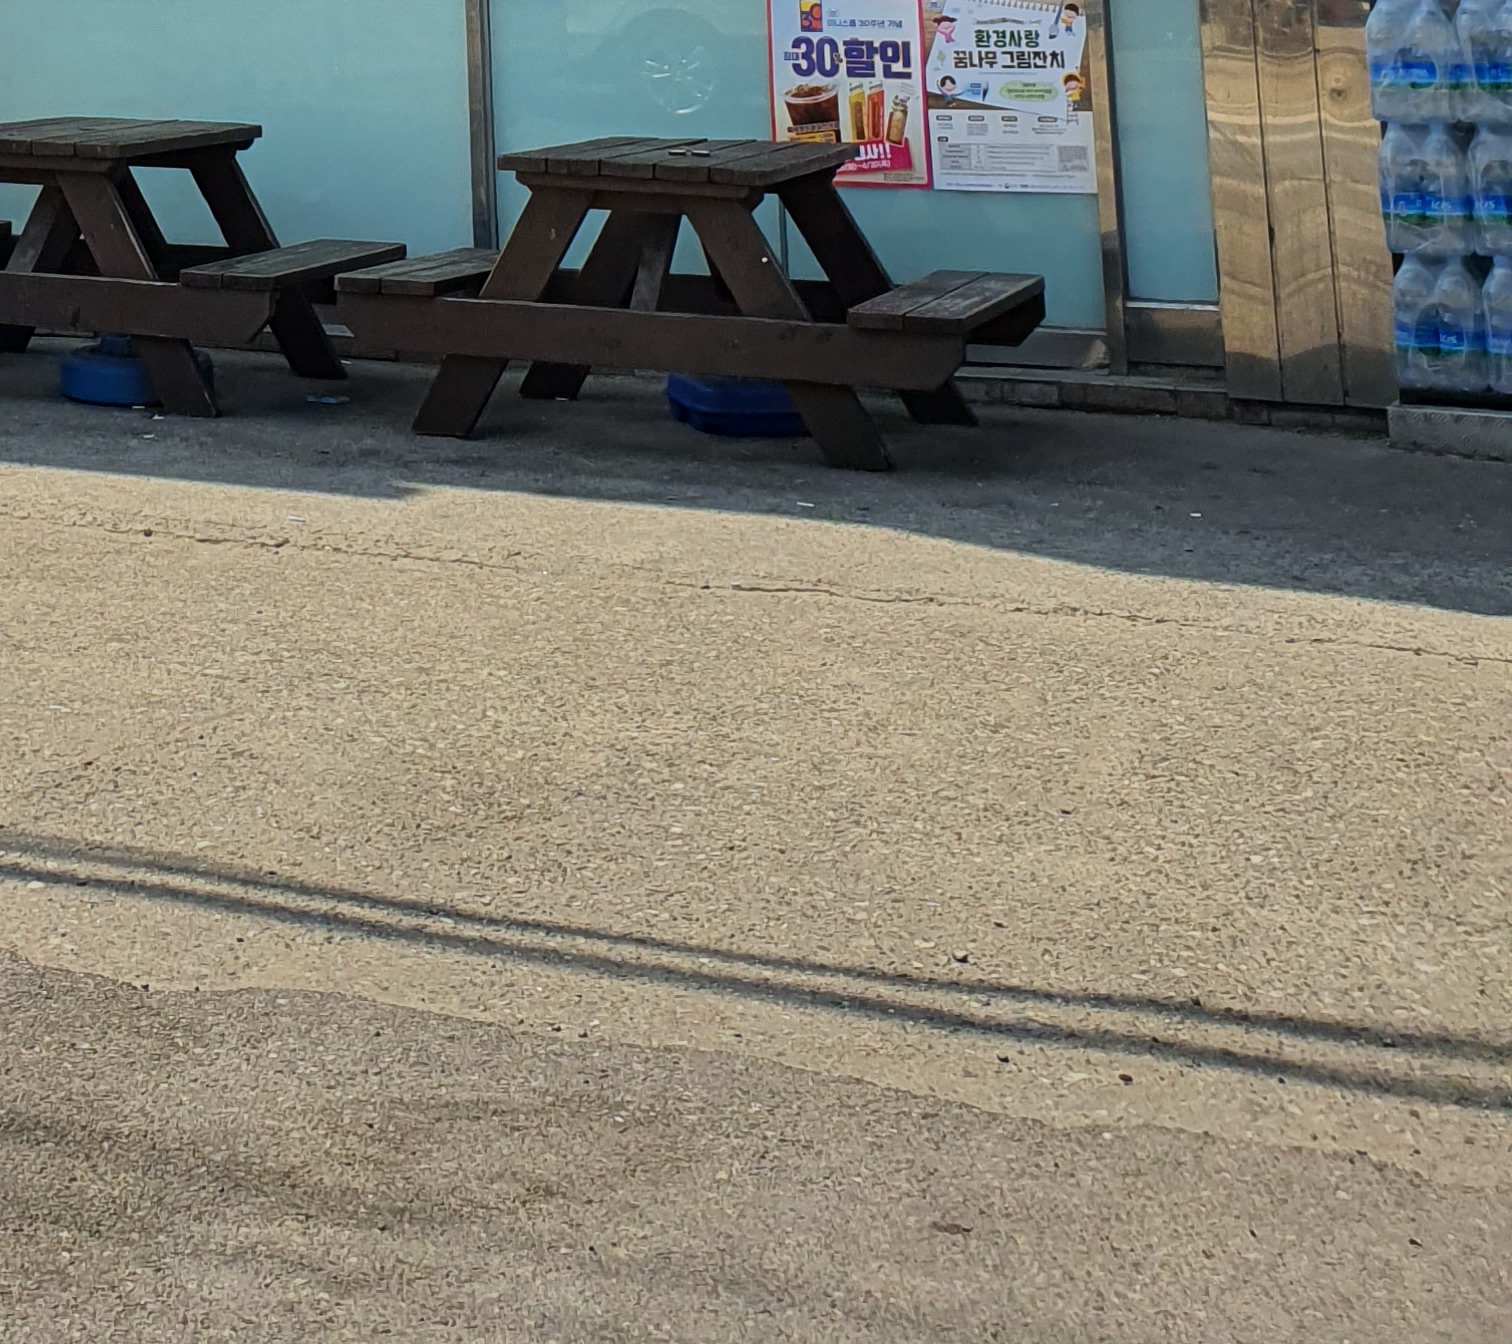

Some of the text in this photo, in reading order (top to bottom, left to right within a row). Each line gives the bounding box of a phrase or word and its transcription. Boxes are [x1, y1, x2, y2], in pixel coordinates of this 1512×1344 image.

[974, 29, 1040, 49] 환경사랑
[842, 37, 912, 79] 할인
[953, 50, 1065, 69] 꿈나무 그림잔치
